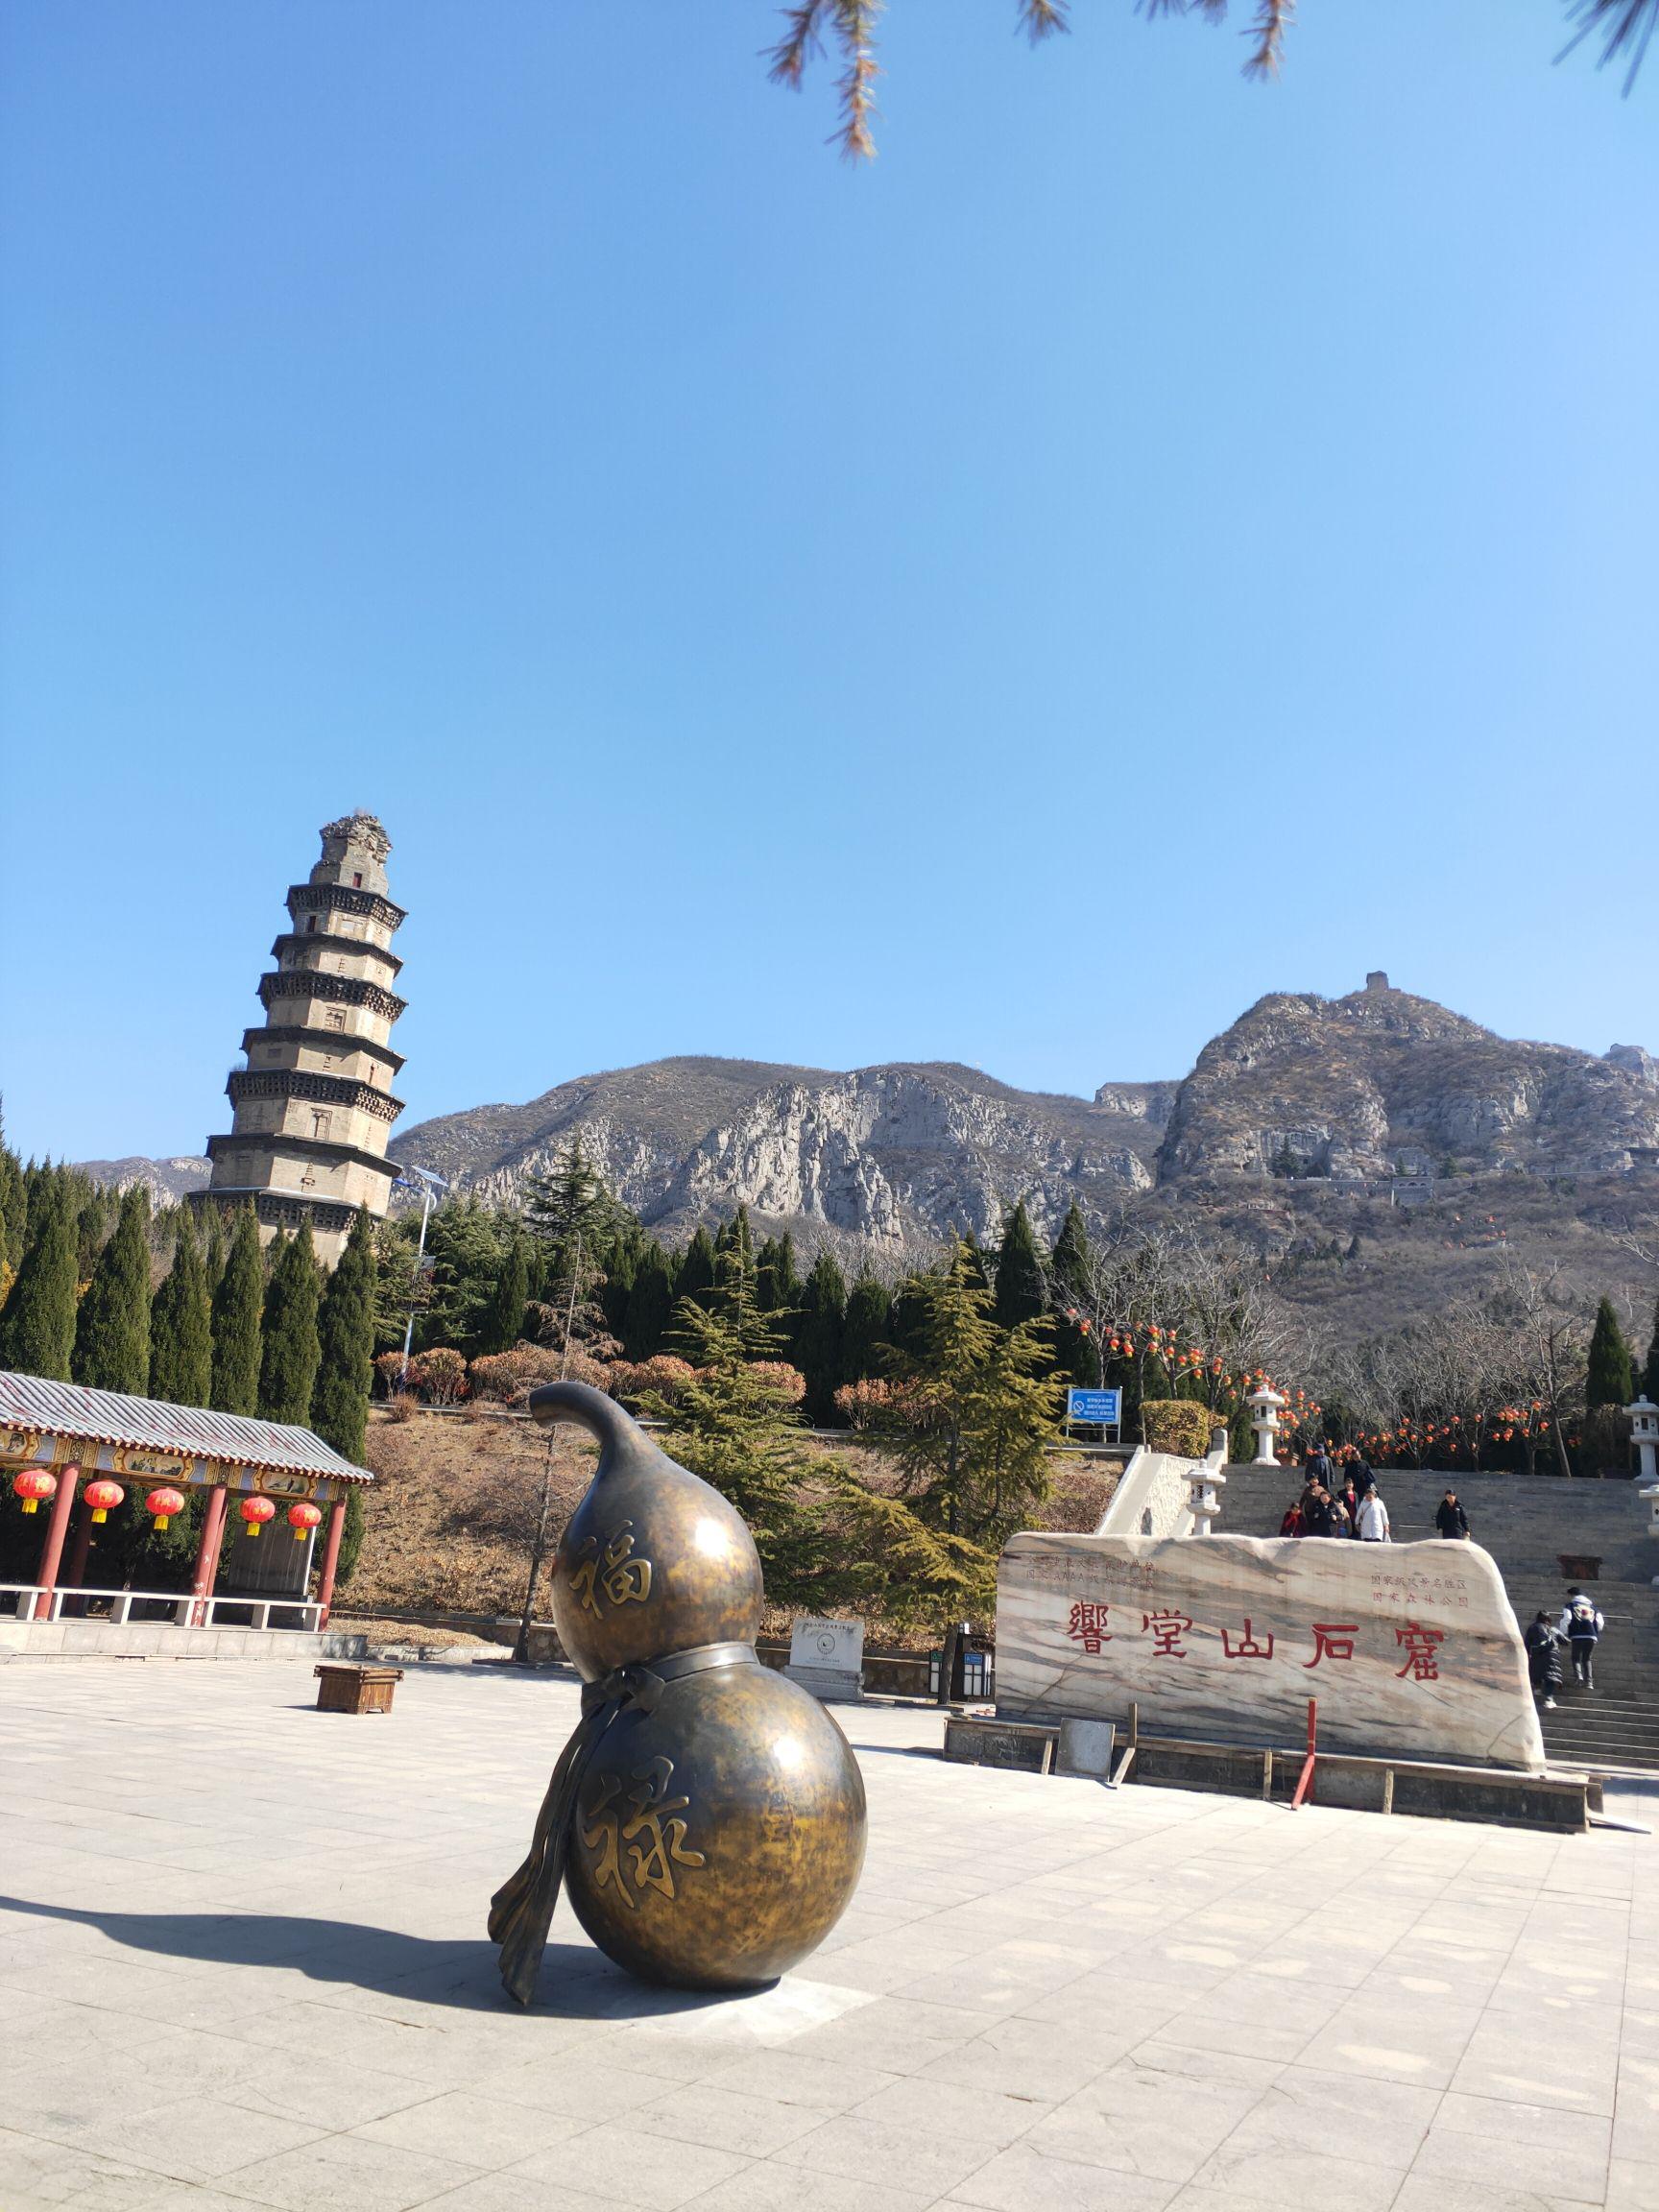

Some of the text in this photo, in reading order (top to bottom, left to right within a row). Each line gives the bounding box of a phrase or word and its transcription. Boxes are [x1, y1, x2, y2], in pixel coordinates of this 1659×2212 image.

[569, 1520, 652, 1620] 福
[1373, 1592, 1469, 1607] 国家森林公园
[1067, 1599, 1444, 1681] 響堂山石窟
[583, 1755, 706, 1910] 禄
